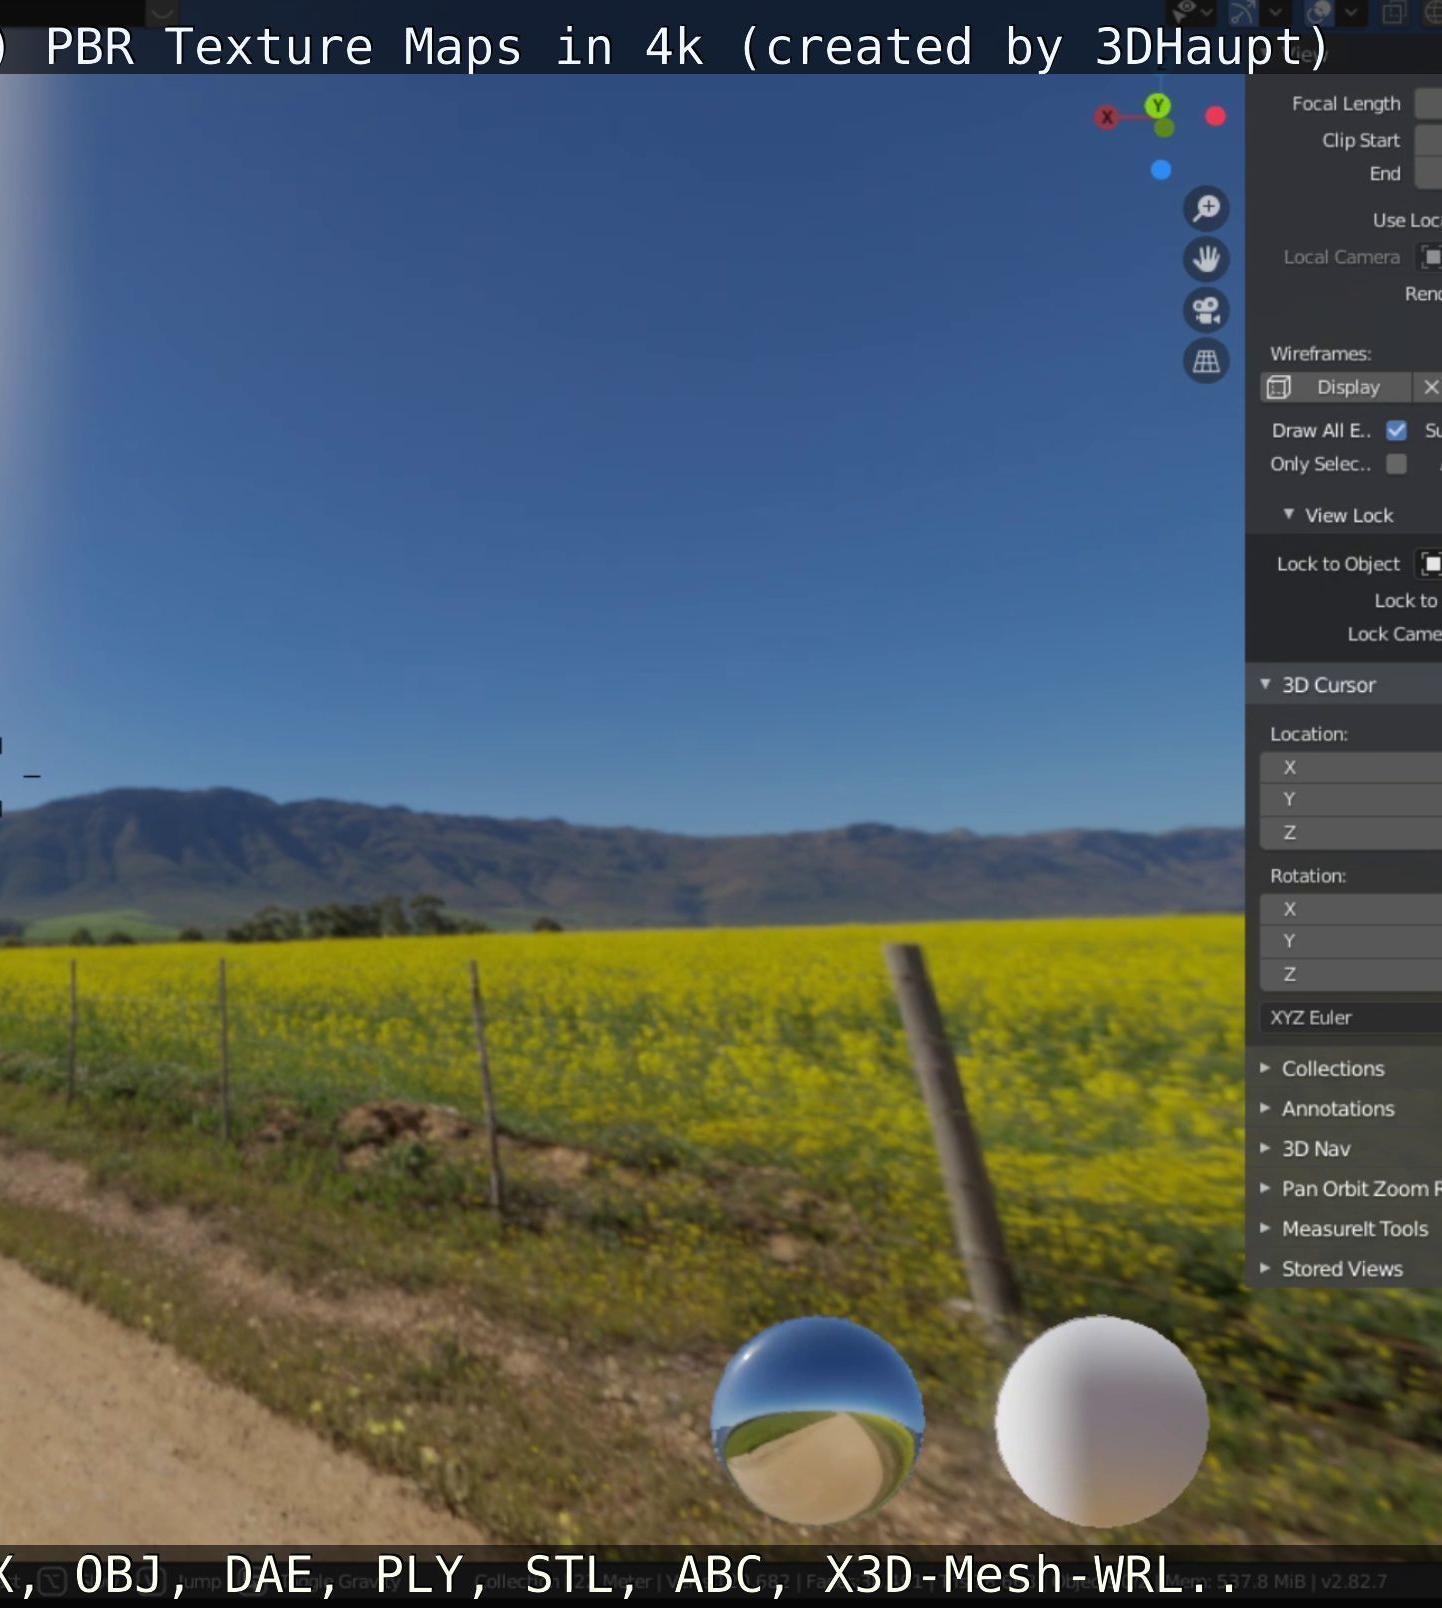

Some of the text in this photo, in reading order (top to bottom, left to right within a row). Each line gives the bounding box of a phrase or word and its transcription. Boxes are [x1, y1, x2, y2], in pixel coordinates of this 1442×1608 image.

[1154, 99, 1164, 113] Y
[1293, 96, 1401, 115] Focal Length
[1102, 111, 1113, 124] X
[1322, 132, 1401, 151] Clip Start
[1370, 165, 1401, 181] End
[1373, 212, 1442, 228] Use Loc
[1284, 248, 1401, 265] Local Camera
[1270, 345, 1372, 361] Wireframes:
[1318, 379, 1381, 398] Display
[1272, 422, 1371, 438] Draw All E..
[1270, 455, 1371, 475] Only Selec..
[1305, 507, 1394, 523] View Lock
[1277, 555, 1401, 575] Lock to Object
[1375, 592, 1438, 608] Lock to
[1348, 625, 1442, 642] Lock Came
[1283, 676, 1377, 693] 3D Cursor
[1271, 726, 1349, 742] Location:
[1284, 759, 1296, 775] X
[1283, 791, 1296, 807] Y
[1283, 824, 1297, 840] Z
[1271, 868, 1347, 884] Rotation:
[1284, 901, 1296, 917] X
[1283, 933, 1296, 949] Y
[1283, 966, 1297, 982] Z
[1270, 1009, 1353, 1026] XYZ Euler
[1282, 1060, 1386, 1077] Collections
[1281, 1100, 1395, 1117] Annotations
[1283, 1140, 1351, 1157] 3D Nav
[1283, 1180, 1318, 1197] Pan
[1323, 1180, 1370, 1197] Orbit
[1373, 1180, 1430, 1197] Zoom
[1283, 1220, 1429, 1237] MeasureIt Tools
[1282, 1260, 1404, 1277] Stored Views
[1217, 1573, 1268, 1589] 537.8
[1274, 1573, 1306, 1589] MiB
[1321, 1573, 1388, 1589] v2.82.7
